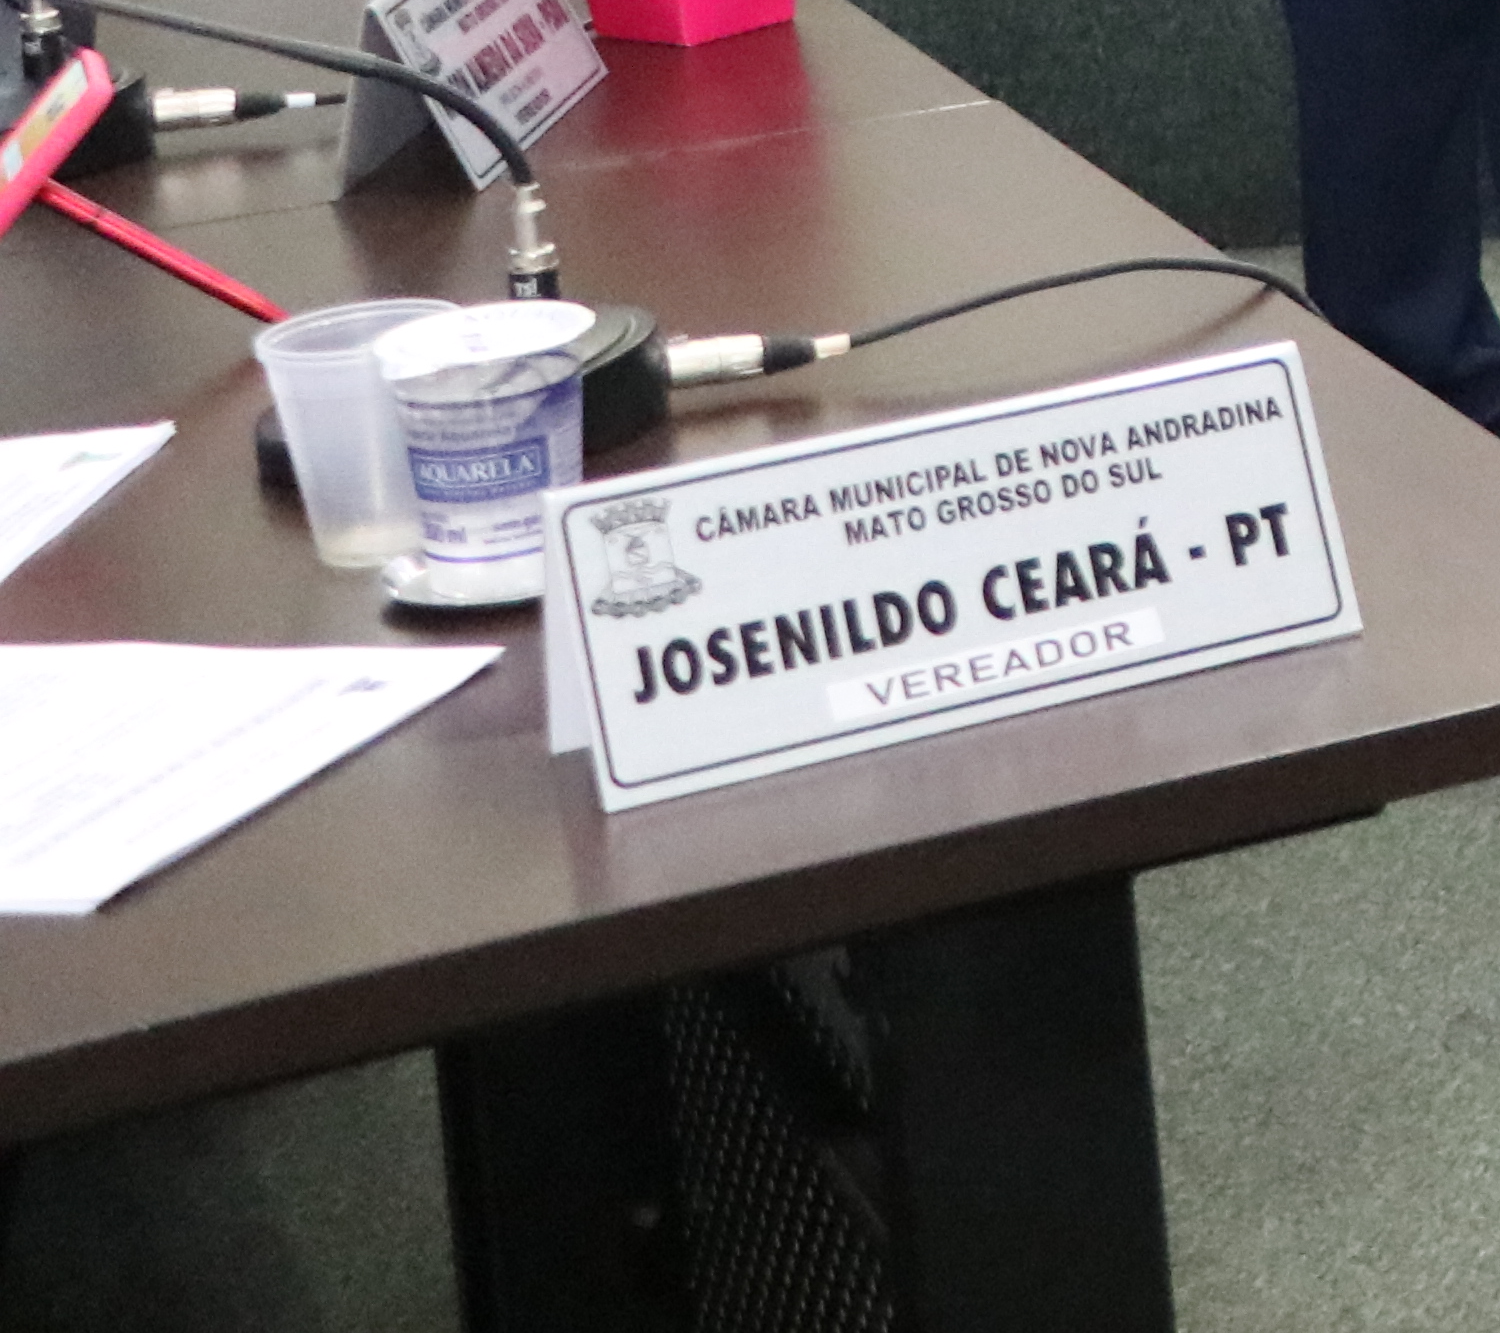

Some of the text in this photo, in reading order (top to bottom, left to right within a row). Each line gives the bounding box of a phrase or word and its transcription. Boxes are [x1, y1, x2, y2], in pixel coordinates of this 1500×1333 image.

[695, 395, 1285, 544] CÂMARA MUNICIPAL DE NOVA ANDRADINA
[844, 454, 1164, 547] MATO GROSSO DO SUL
[633, 502, 1293, 706] JOSENILDO CEARÁ - PT
[866, 619, 1135, 708] VEREADOR
